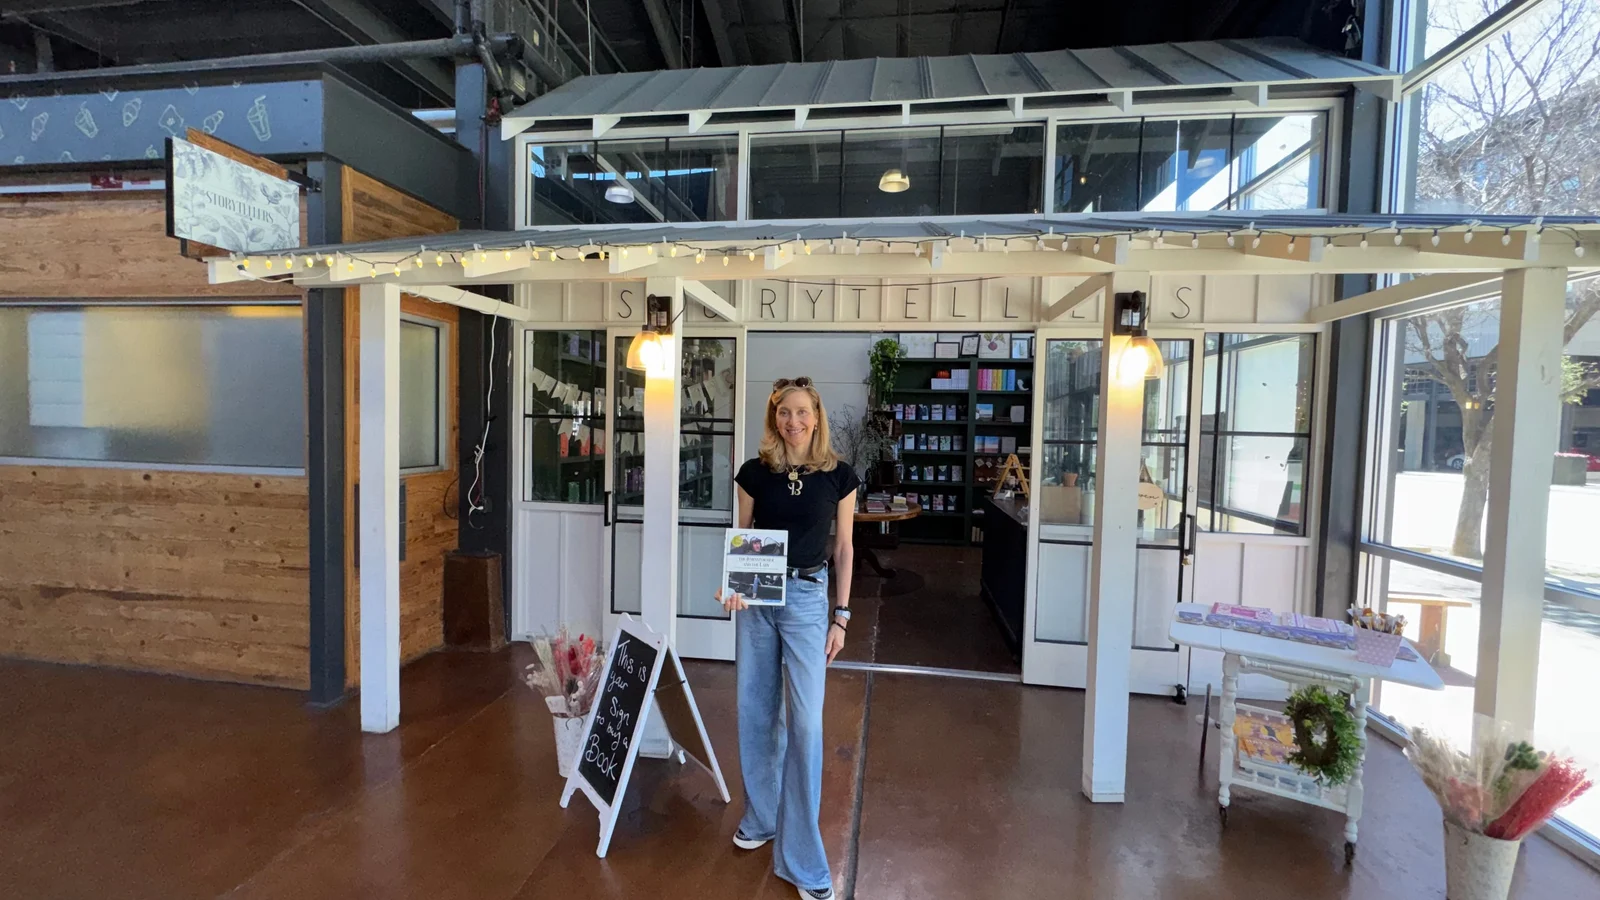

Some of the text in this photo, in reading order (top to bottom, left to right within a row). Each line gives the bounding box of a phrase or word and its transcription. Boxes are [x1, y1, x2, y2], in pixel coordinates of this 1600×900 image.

[206, 191, 274, 223] STORYTELLERS
[617, 639, 647, 682] This is
[607, 671, 628, 693] your
[609, 696, 630, 730] Sign
[596, 712, 628, 751] to buy a
[585, 734, 617, 781] Book
